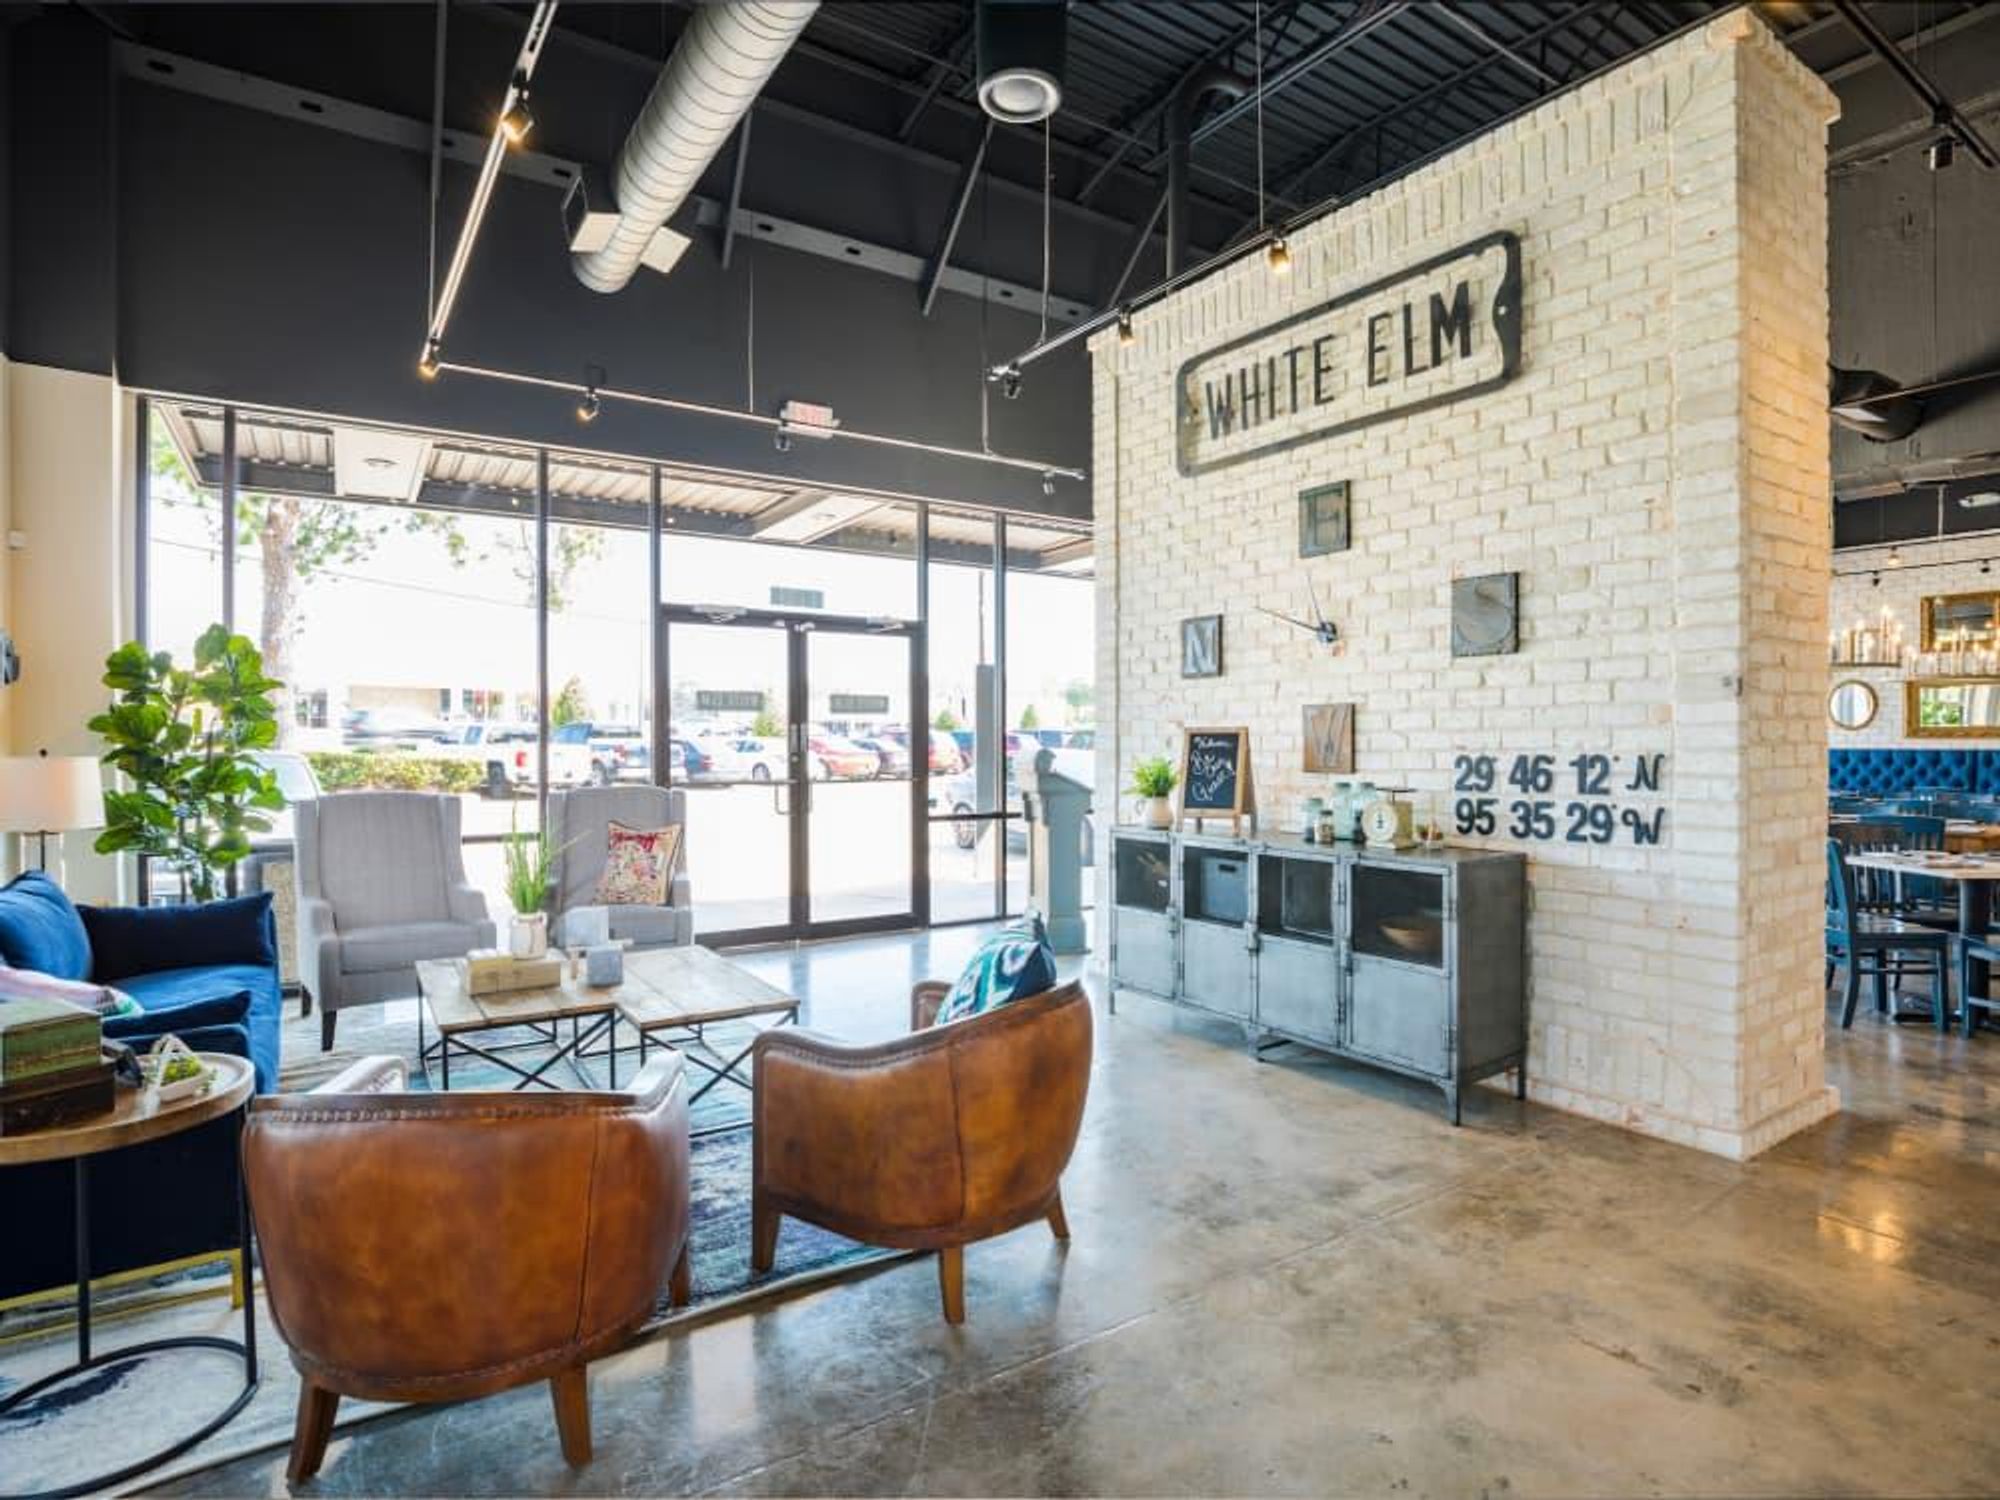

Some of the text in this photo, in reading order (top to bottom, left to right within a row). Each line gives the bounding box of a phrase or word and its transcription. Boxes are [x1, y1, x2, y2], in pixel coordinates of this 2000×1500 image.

[1206, 281, 1472, 439] WHITE ELM
[1184, 621, 1217, 674] N
[1625, 753, 1665, 791] N
[1621, 806, 1665, 844] W
